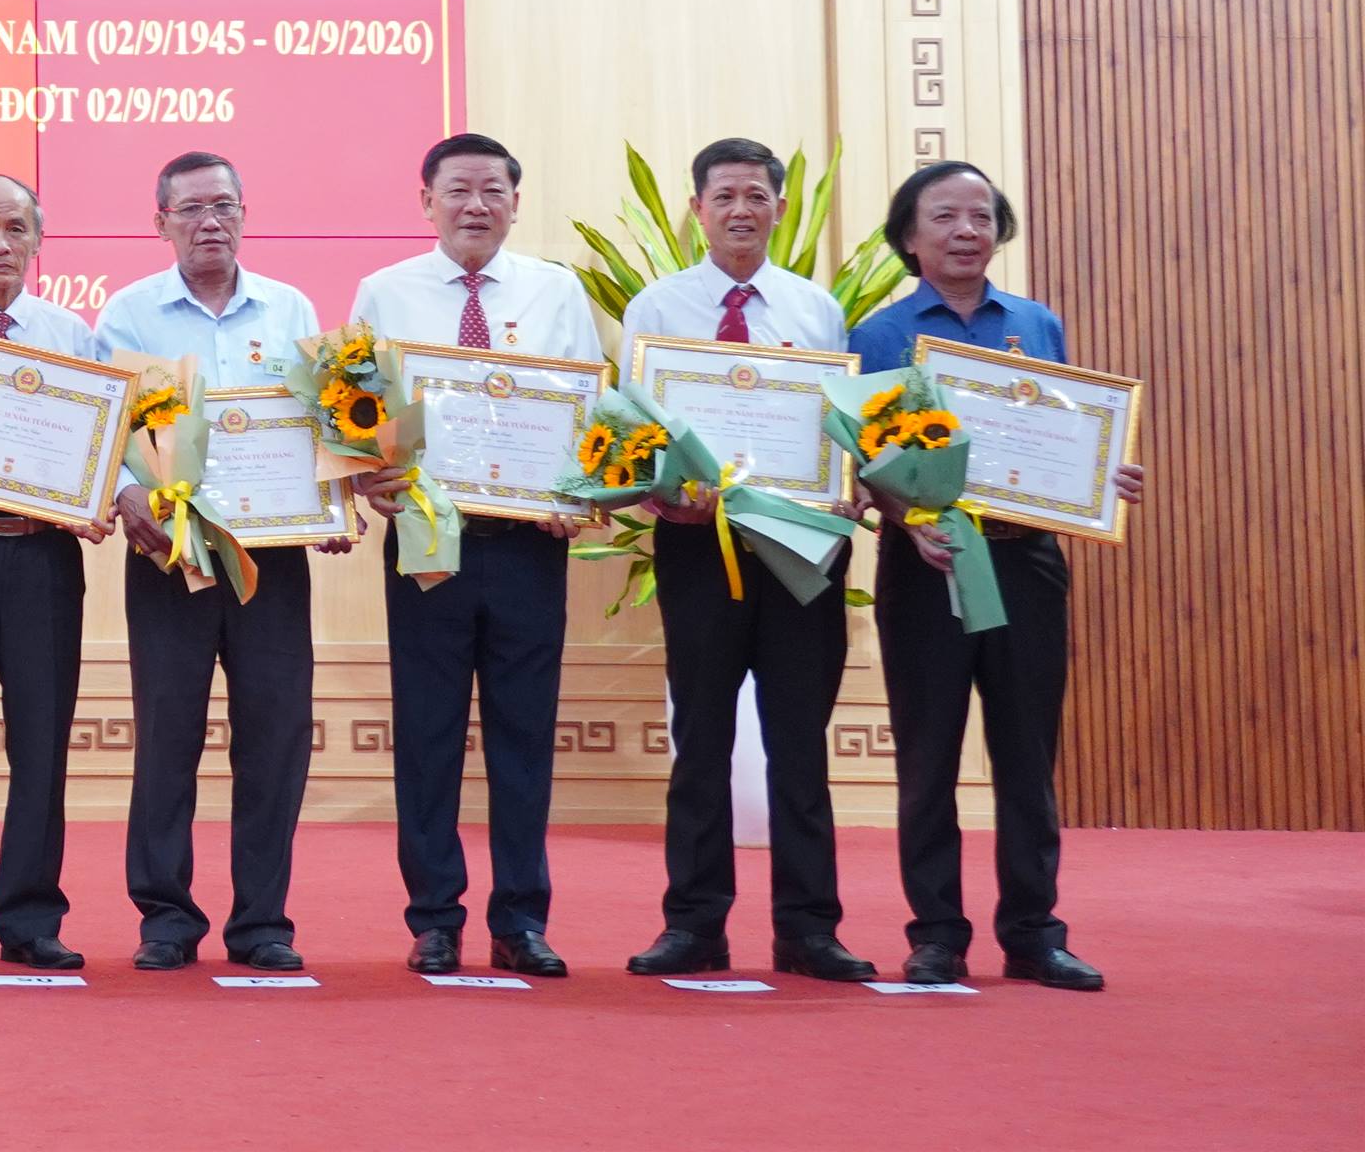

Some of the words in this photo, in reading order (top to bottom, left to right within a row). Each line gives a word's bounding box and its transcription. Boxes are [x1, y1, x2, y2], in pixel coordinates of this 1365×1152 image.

[86, 19, 245, 65] (02/9/1945
[252, 38, 267, 46] -
[274, 19, 434, 65] 02/9/2026)
[87, 86, 235, 123] 02/9/2026
[38, 274, 109, 311] 2026
